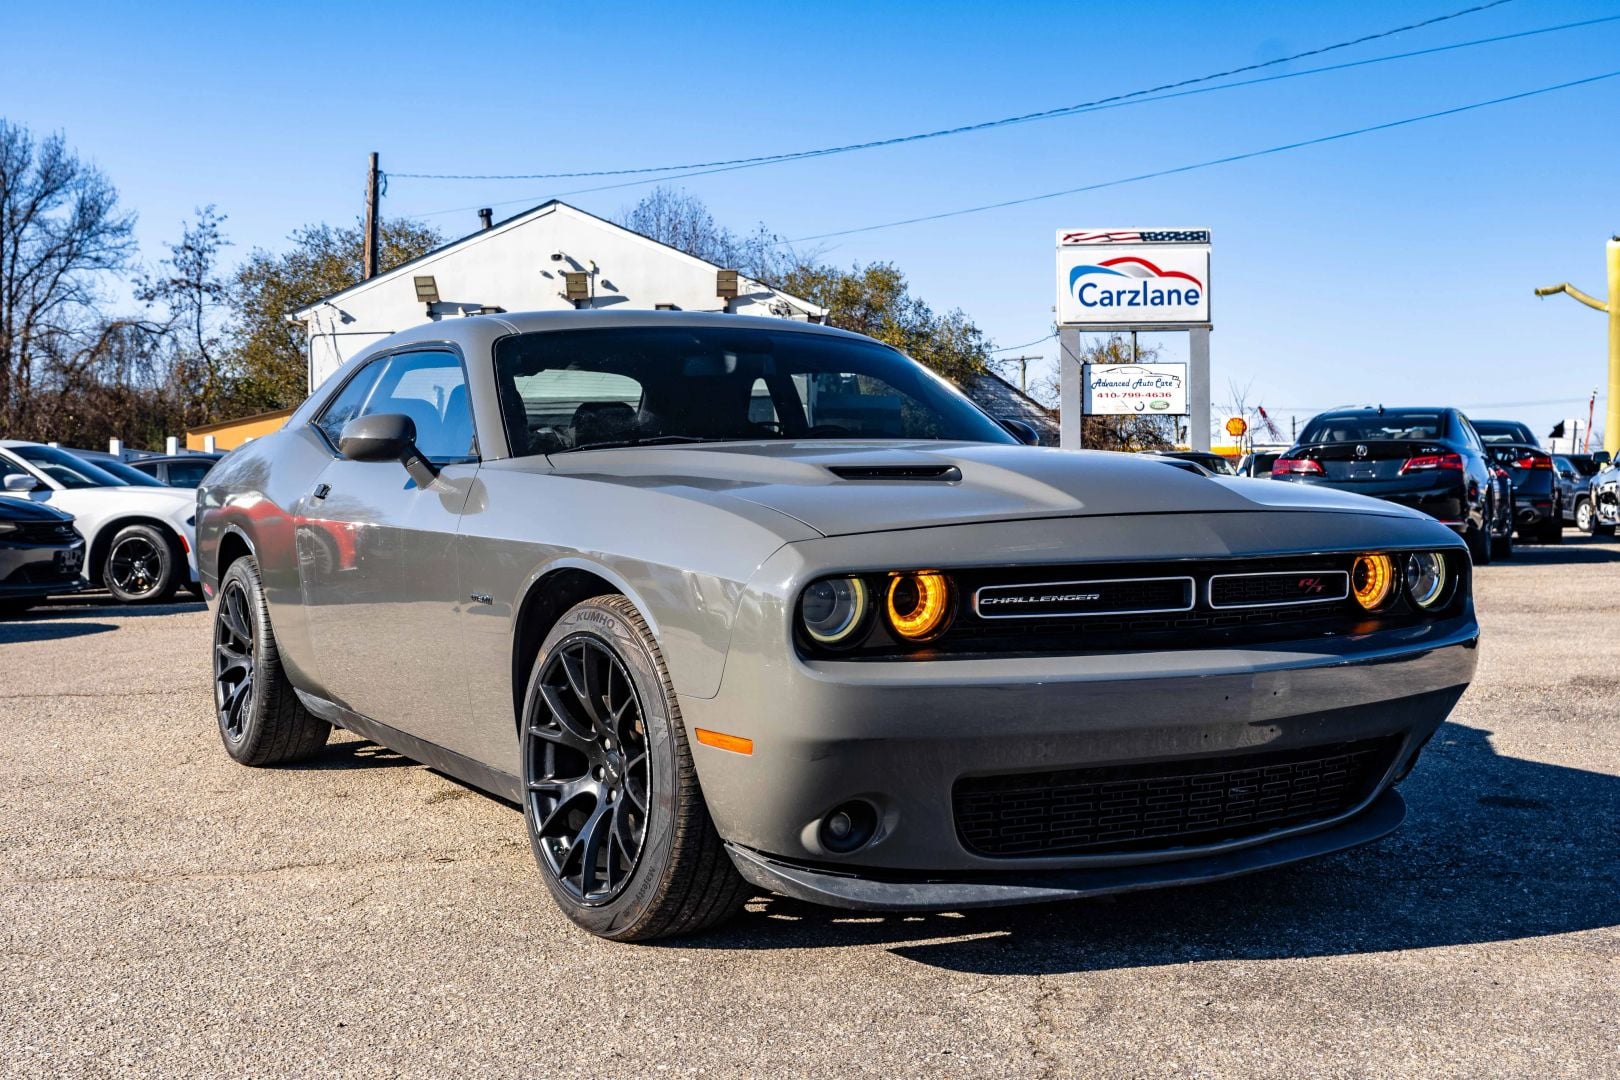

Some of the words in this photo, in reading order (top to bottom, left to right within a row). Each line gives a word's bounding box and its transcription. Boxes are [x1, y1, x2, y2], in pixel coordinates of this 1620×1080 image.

[1078, 280, 1200, 307] Carzlane
[1091, 378, 1131, 390] Advanced
[1132, 378, 1154, 390] Auto
[1155, 378, 1173, 389] Care
[1298, 577, 1327, 593] R/T
[980, 593, 1100, 605] CHALLENGER
[576, 611, 615, 629] KUMHO
